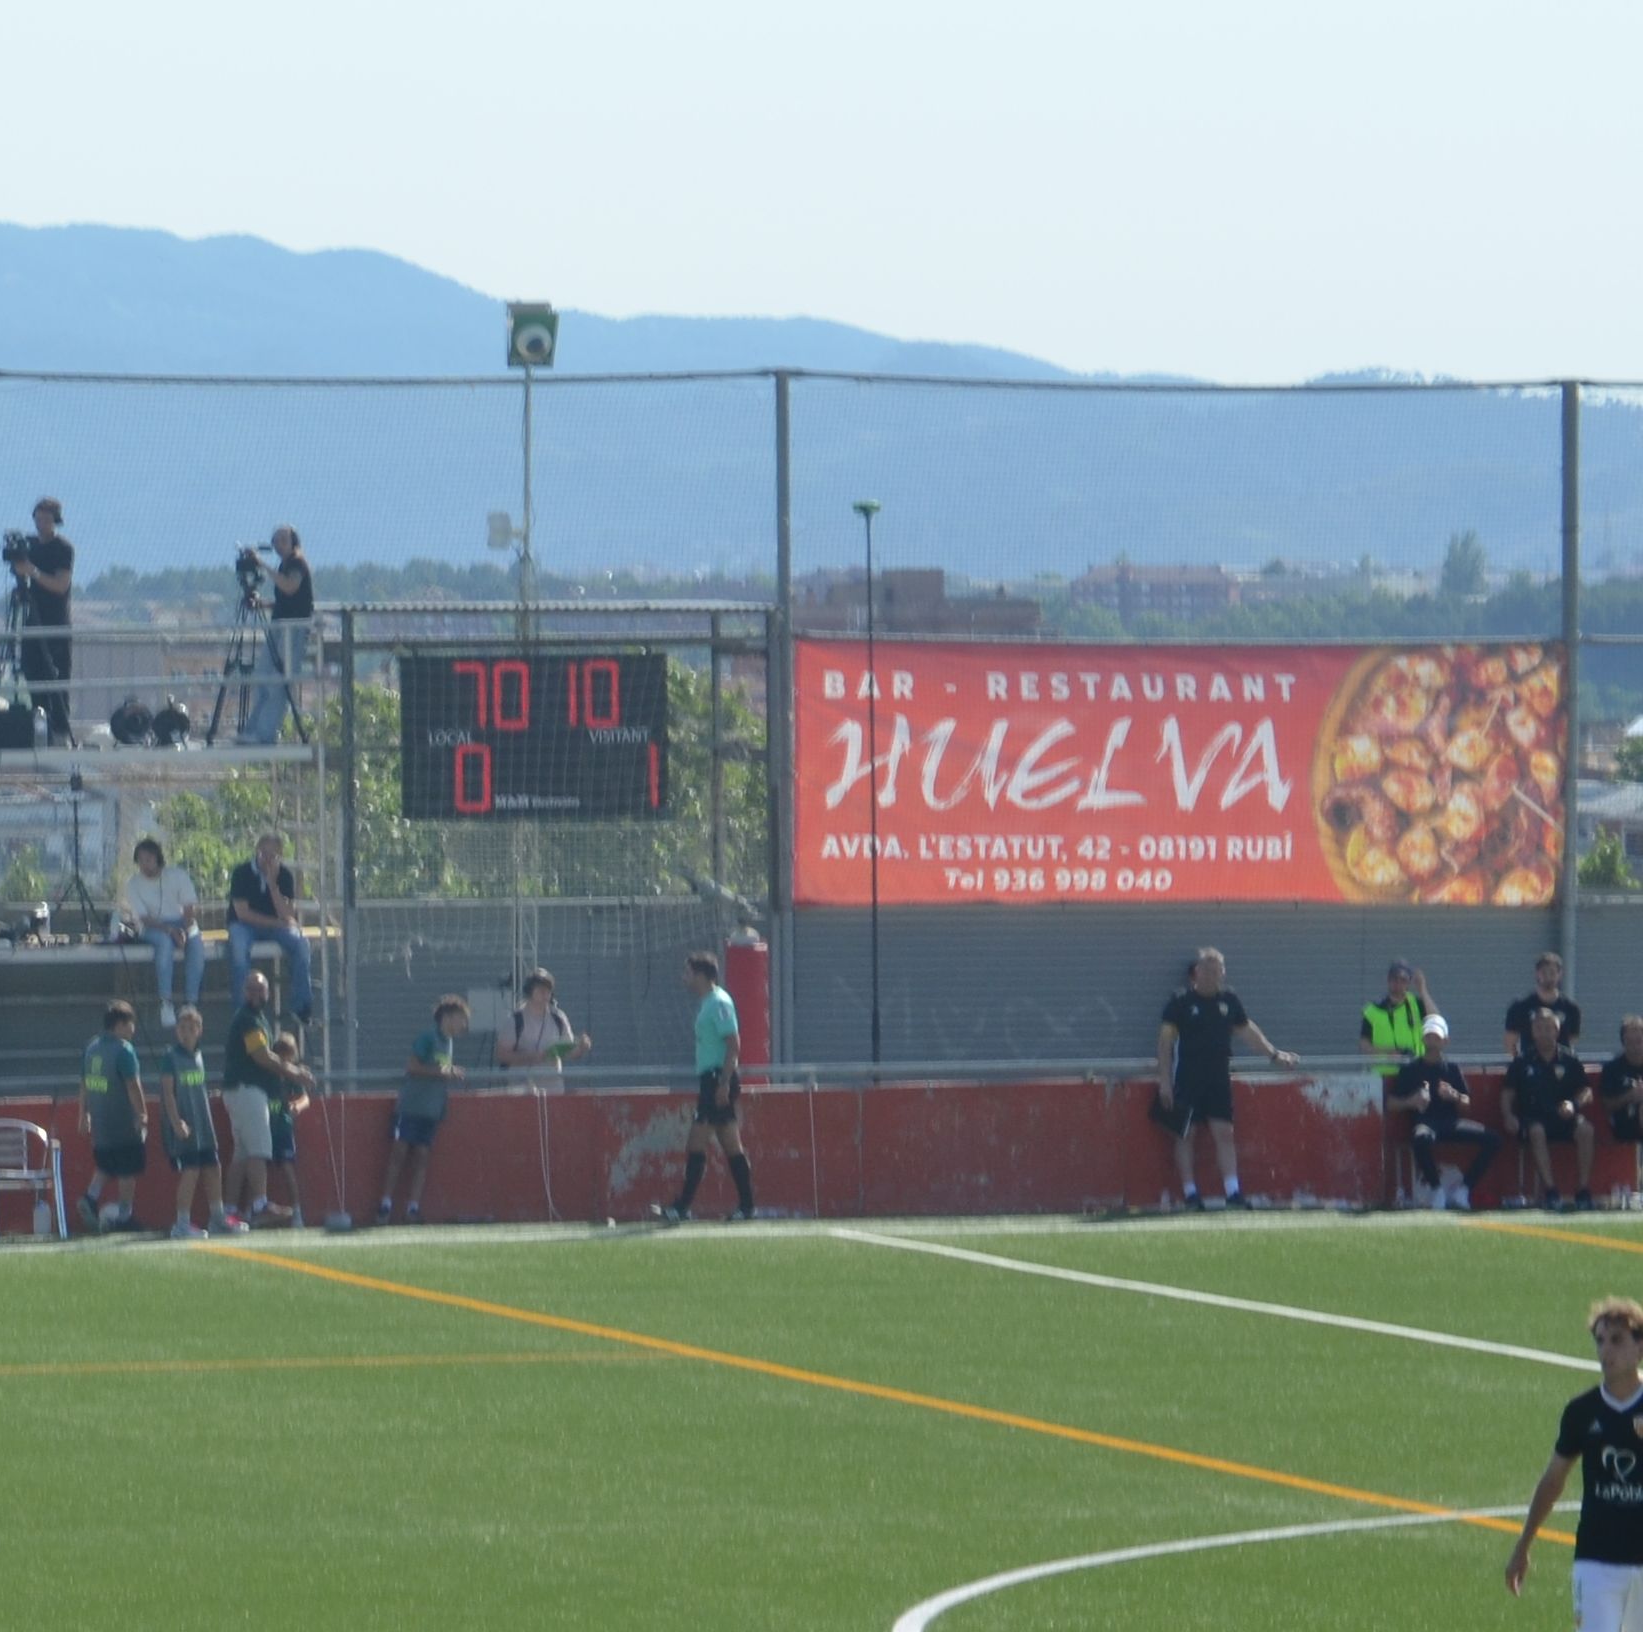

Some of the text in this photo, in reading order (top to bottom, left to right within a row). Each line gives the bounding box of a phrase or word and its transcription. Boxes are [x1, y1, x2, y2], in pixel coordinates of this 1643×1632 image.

[452, 659, 620, 730] 70 10
[824, 670, 915, 700] BAR
[987, 671, 1295, 702] RESTAURANT
[428, 730, 472, 746] LOCAL
[588, 728, 648, 745] VISITANT
[455, 742, 659, 813] 0 1
[827, 712, 1294, 813] HUELVA
[822, 833, 909, 859] AVDA.
[919, 834, 1068, 863] L'ESTATUT,
[1077, 835, 1111, 860] 42
[1139, 835, 1217, 861] 08191
[945, 867, 984, 890] Tel
[994, 868, 1045, 892] 936
[1116, 868, 1172, 892] 040
